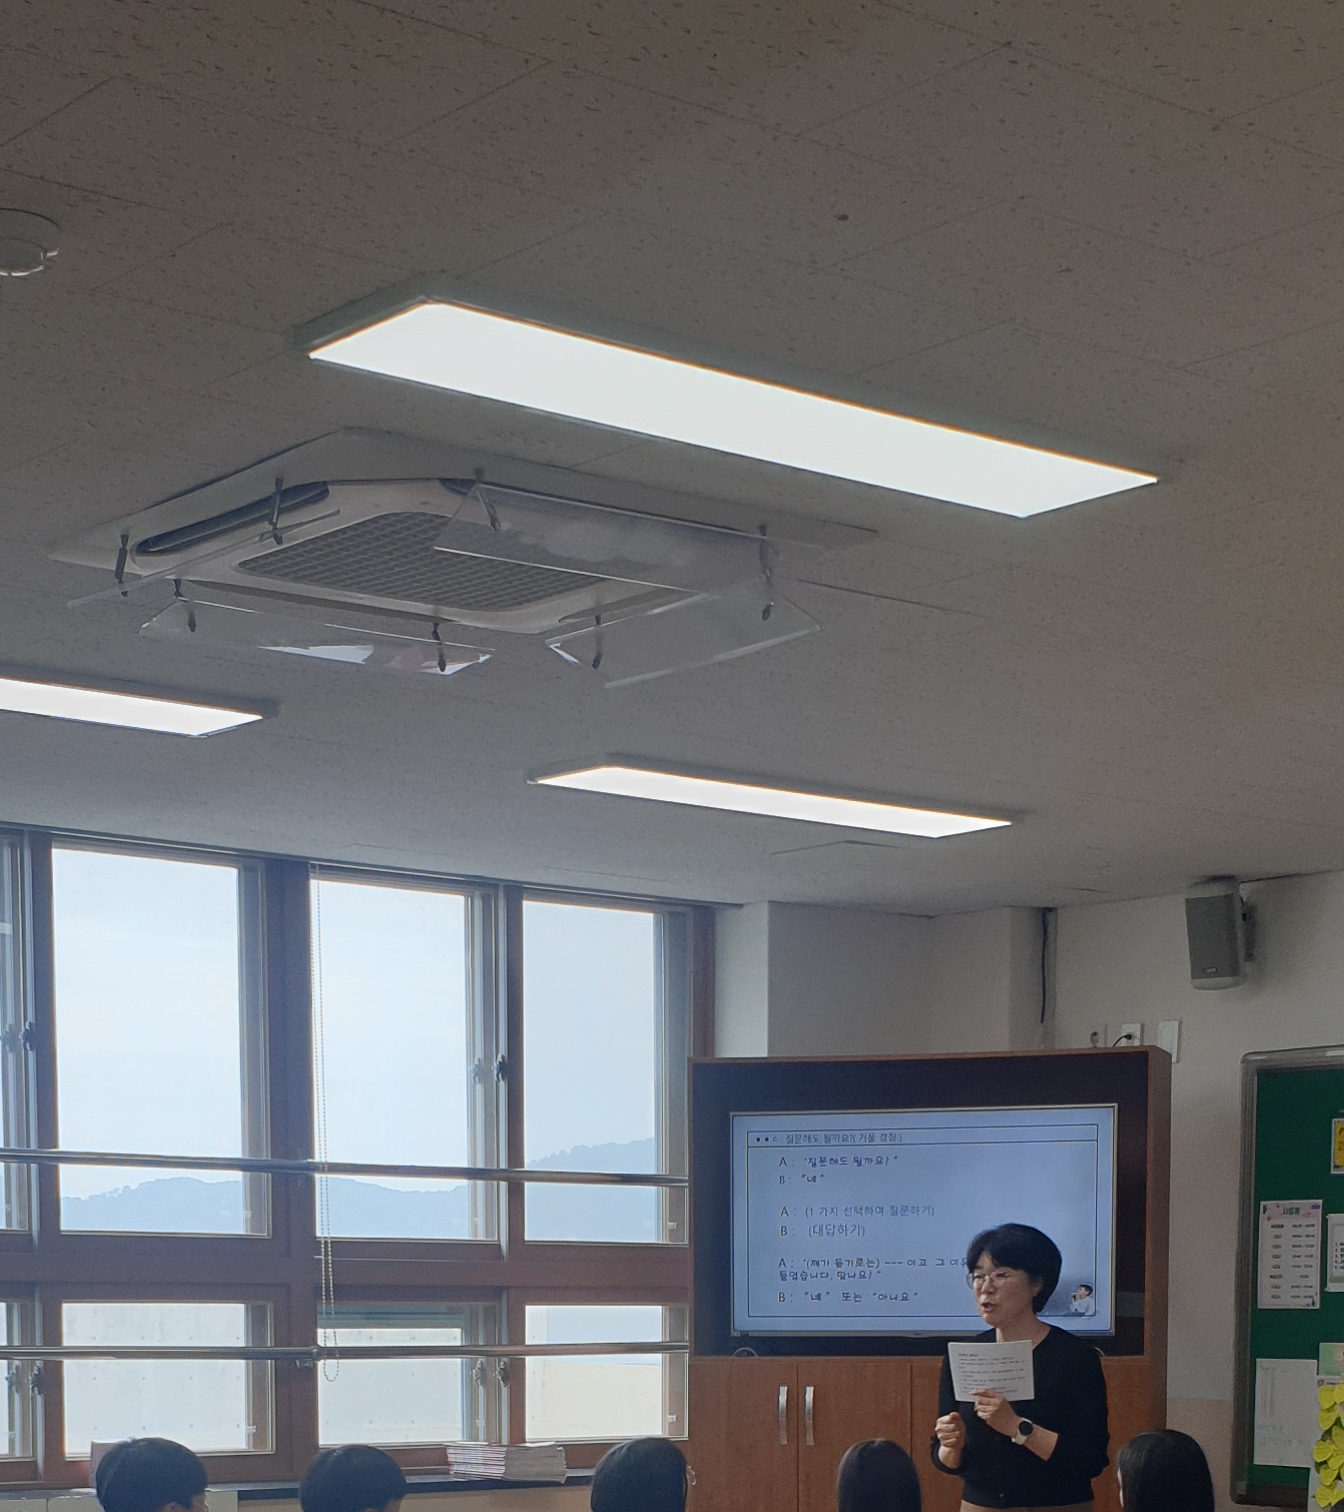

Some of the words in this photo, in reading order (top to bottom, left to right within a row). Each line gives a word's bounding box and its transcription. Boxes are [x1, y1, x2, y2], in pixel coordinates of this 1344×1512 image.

[819, 1206, 839, 1216] 가지
[907, 1258, 927, 1268] 이고
[935, 1258, 945, 1266] 그
[842, 1292, 862, 1303] 또는
